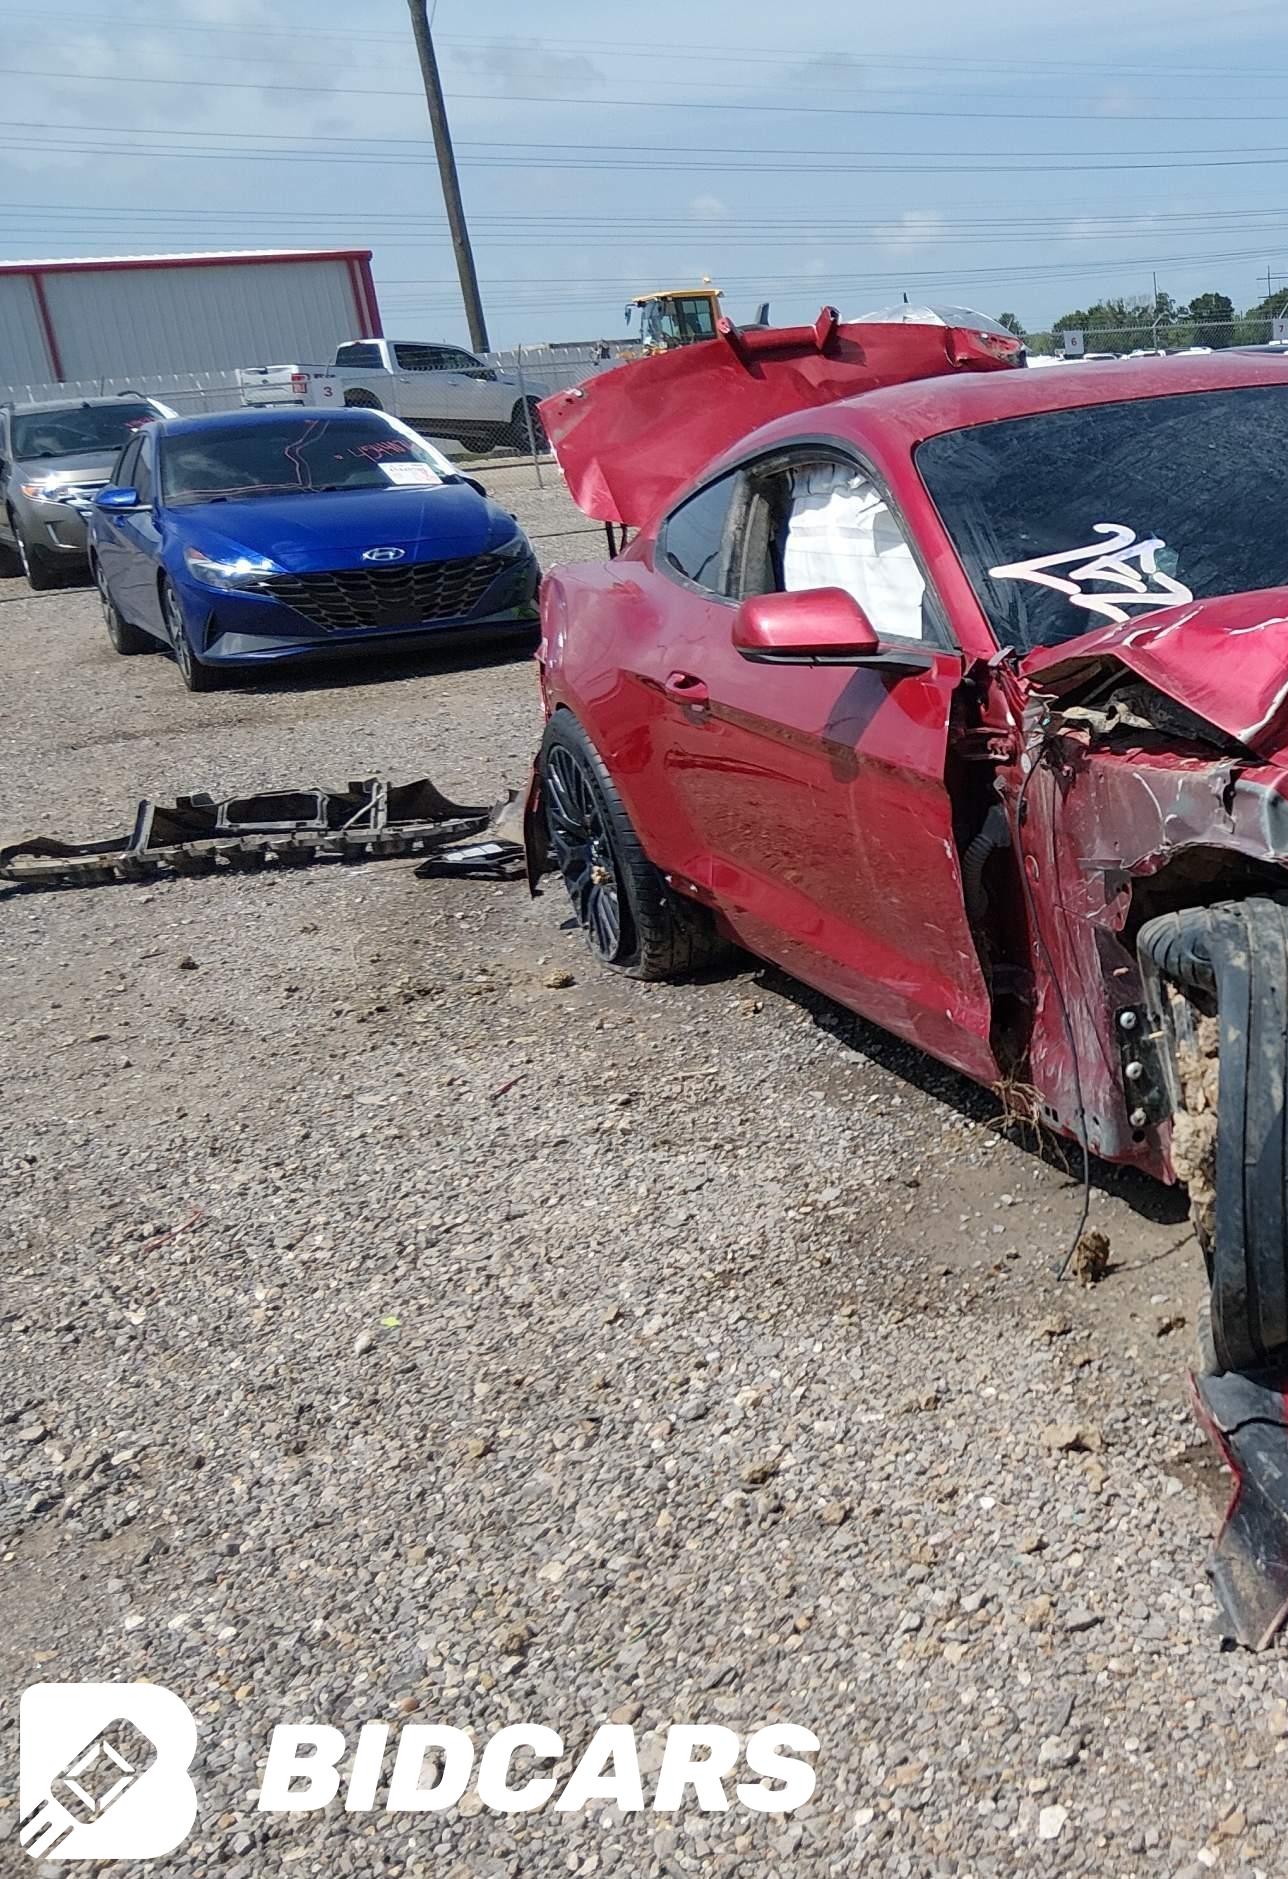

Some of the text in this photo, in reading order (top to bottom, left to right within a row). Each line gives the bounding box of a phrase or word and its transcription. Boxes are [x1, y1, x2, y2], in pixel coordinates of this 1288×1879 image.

[1279, 324, 1284, 333] 7
[1071, 336, 1078, 346] 6
[323, 386, 333, 397] 3
